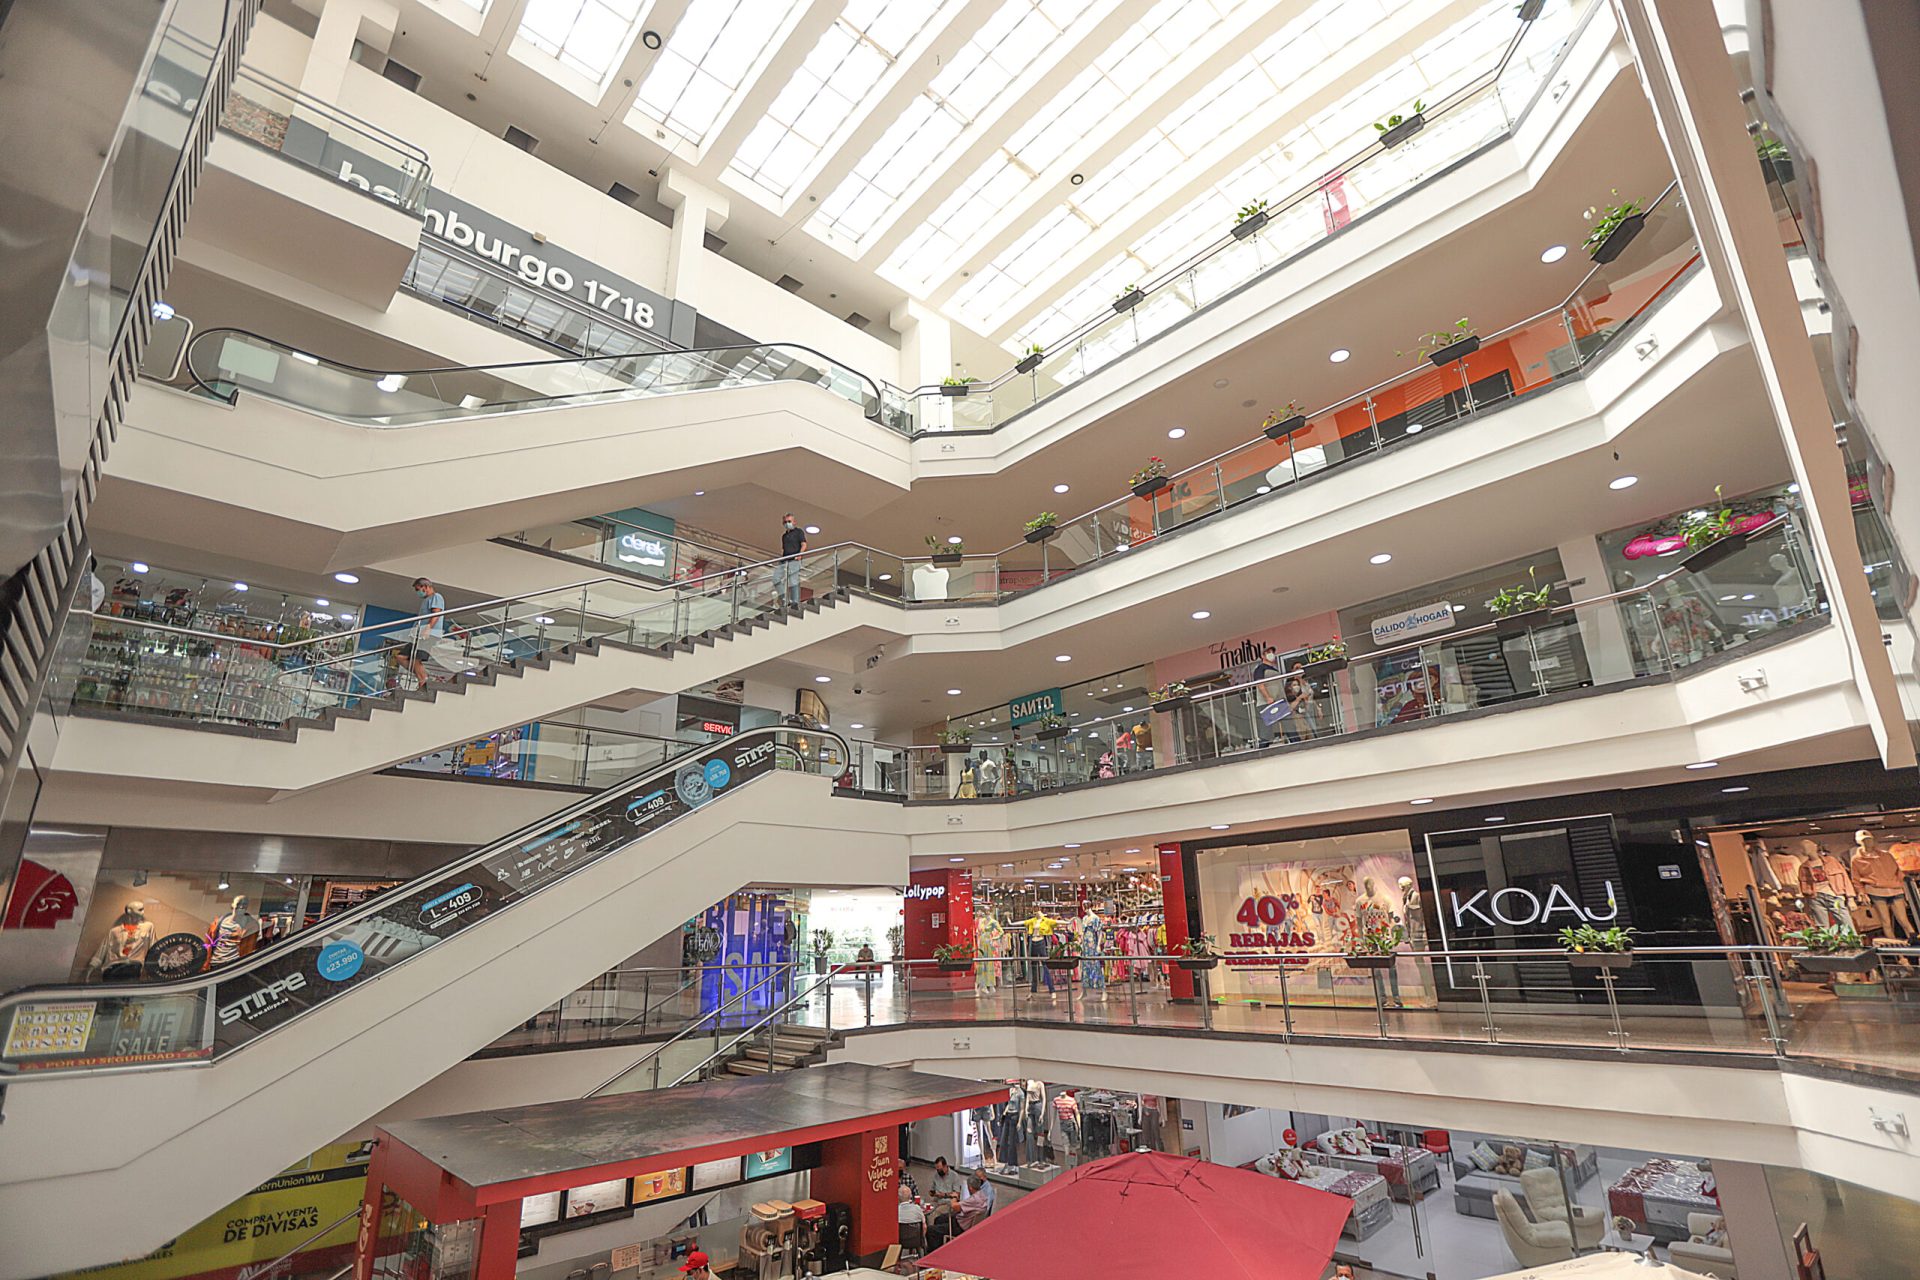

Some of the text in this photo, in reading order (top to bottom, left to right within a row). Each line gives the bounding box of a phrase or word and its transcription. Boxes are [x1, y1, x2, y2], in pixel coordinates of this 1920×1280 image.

[583, 279, 655, 329] 1718
[622, 534, 666, 556] derek
[1374, 610, 1449, 635] CÁLIDO HOGAR
[647, 797, 664, 810] 409
[449, 892, 472, 909] 409
[903, 884, 945, 900] Lollypop
[1236, 892, 1300, 928] 40%
[1450, 880, 1618, 928] KOAJ
[1229, 932, 1315, 947] REBAJAS
[116, 1035, 169, 1056] SALE
[45, 1060, 74, 1068] POR
[78, 1058, 95, 1067] SU
[871, 1156, 890, 1169] Juan
[226, 1206, 318, 1229] COMPRA Y VENTA
[224, 1215, 318, 1243] DE DIVISAS
